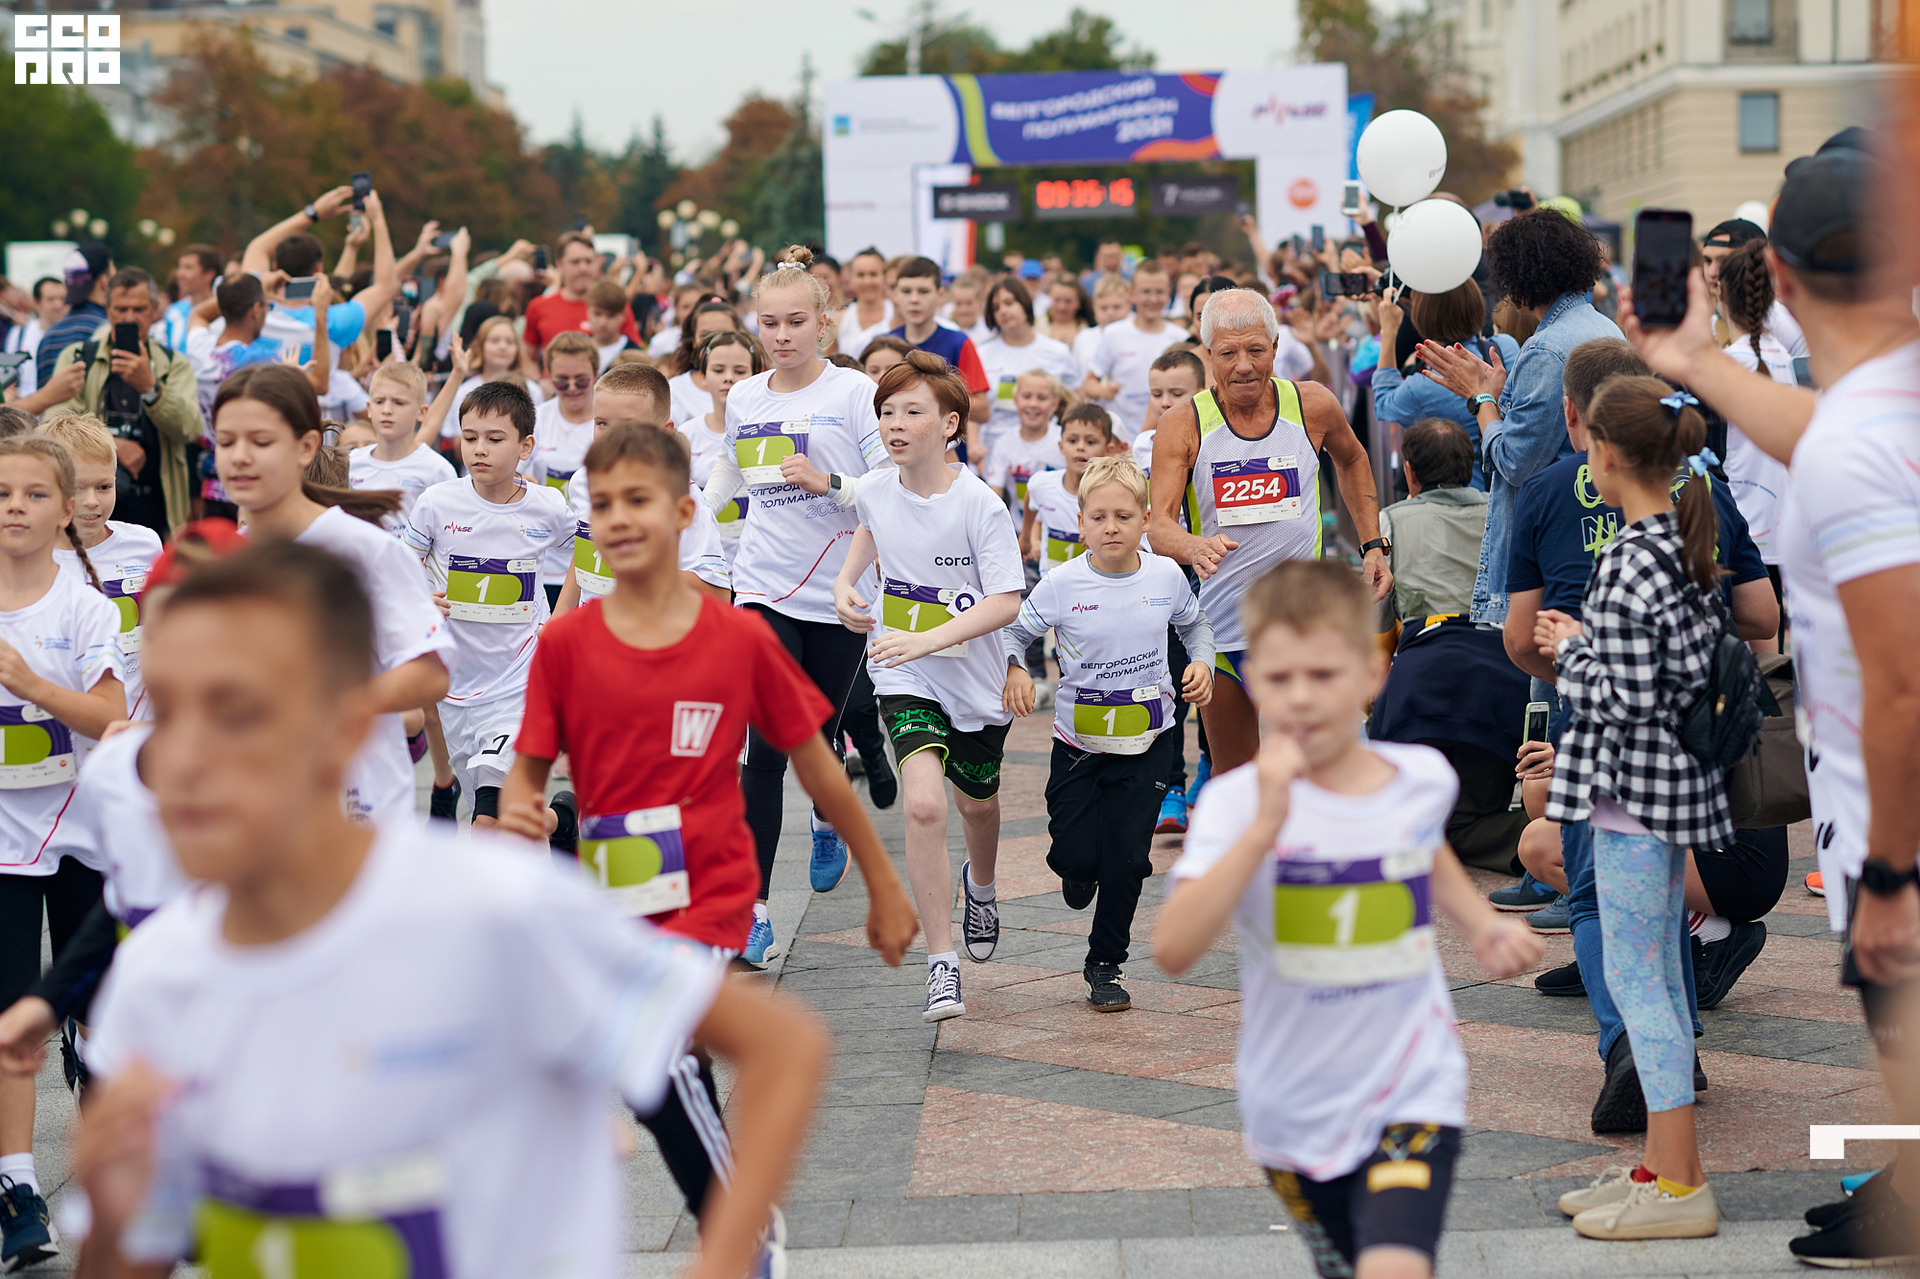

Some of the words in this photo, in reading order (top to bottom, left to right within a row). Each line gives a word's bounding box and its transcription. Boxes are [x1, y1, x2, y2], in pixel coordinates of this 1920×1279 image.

[756, 438, 768, 465] 1
[1220, 477, 1281, 503] 2254
[475, 575, 491, 603] 1
[907, 603, 921, 632] 1
[1080, 647, 1159, 670] БЕЛГОРОДСКИЙ
[679, 708, 713, 749] W
[1102, 708, 1117, 736] 1
[593, 842, 609, 889] 1
[1328, 887, 1361, 948] 1
